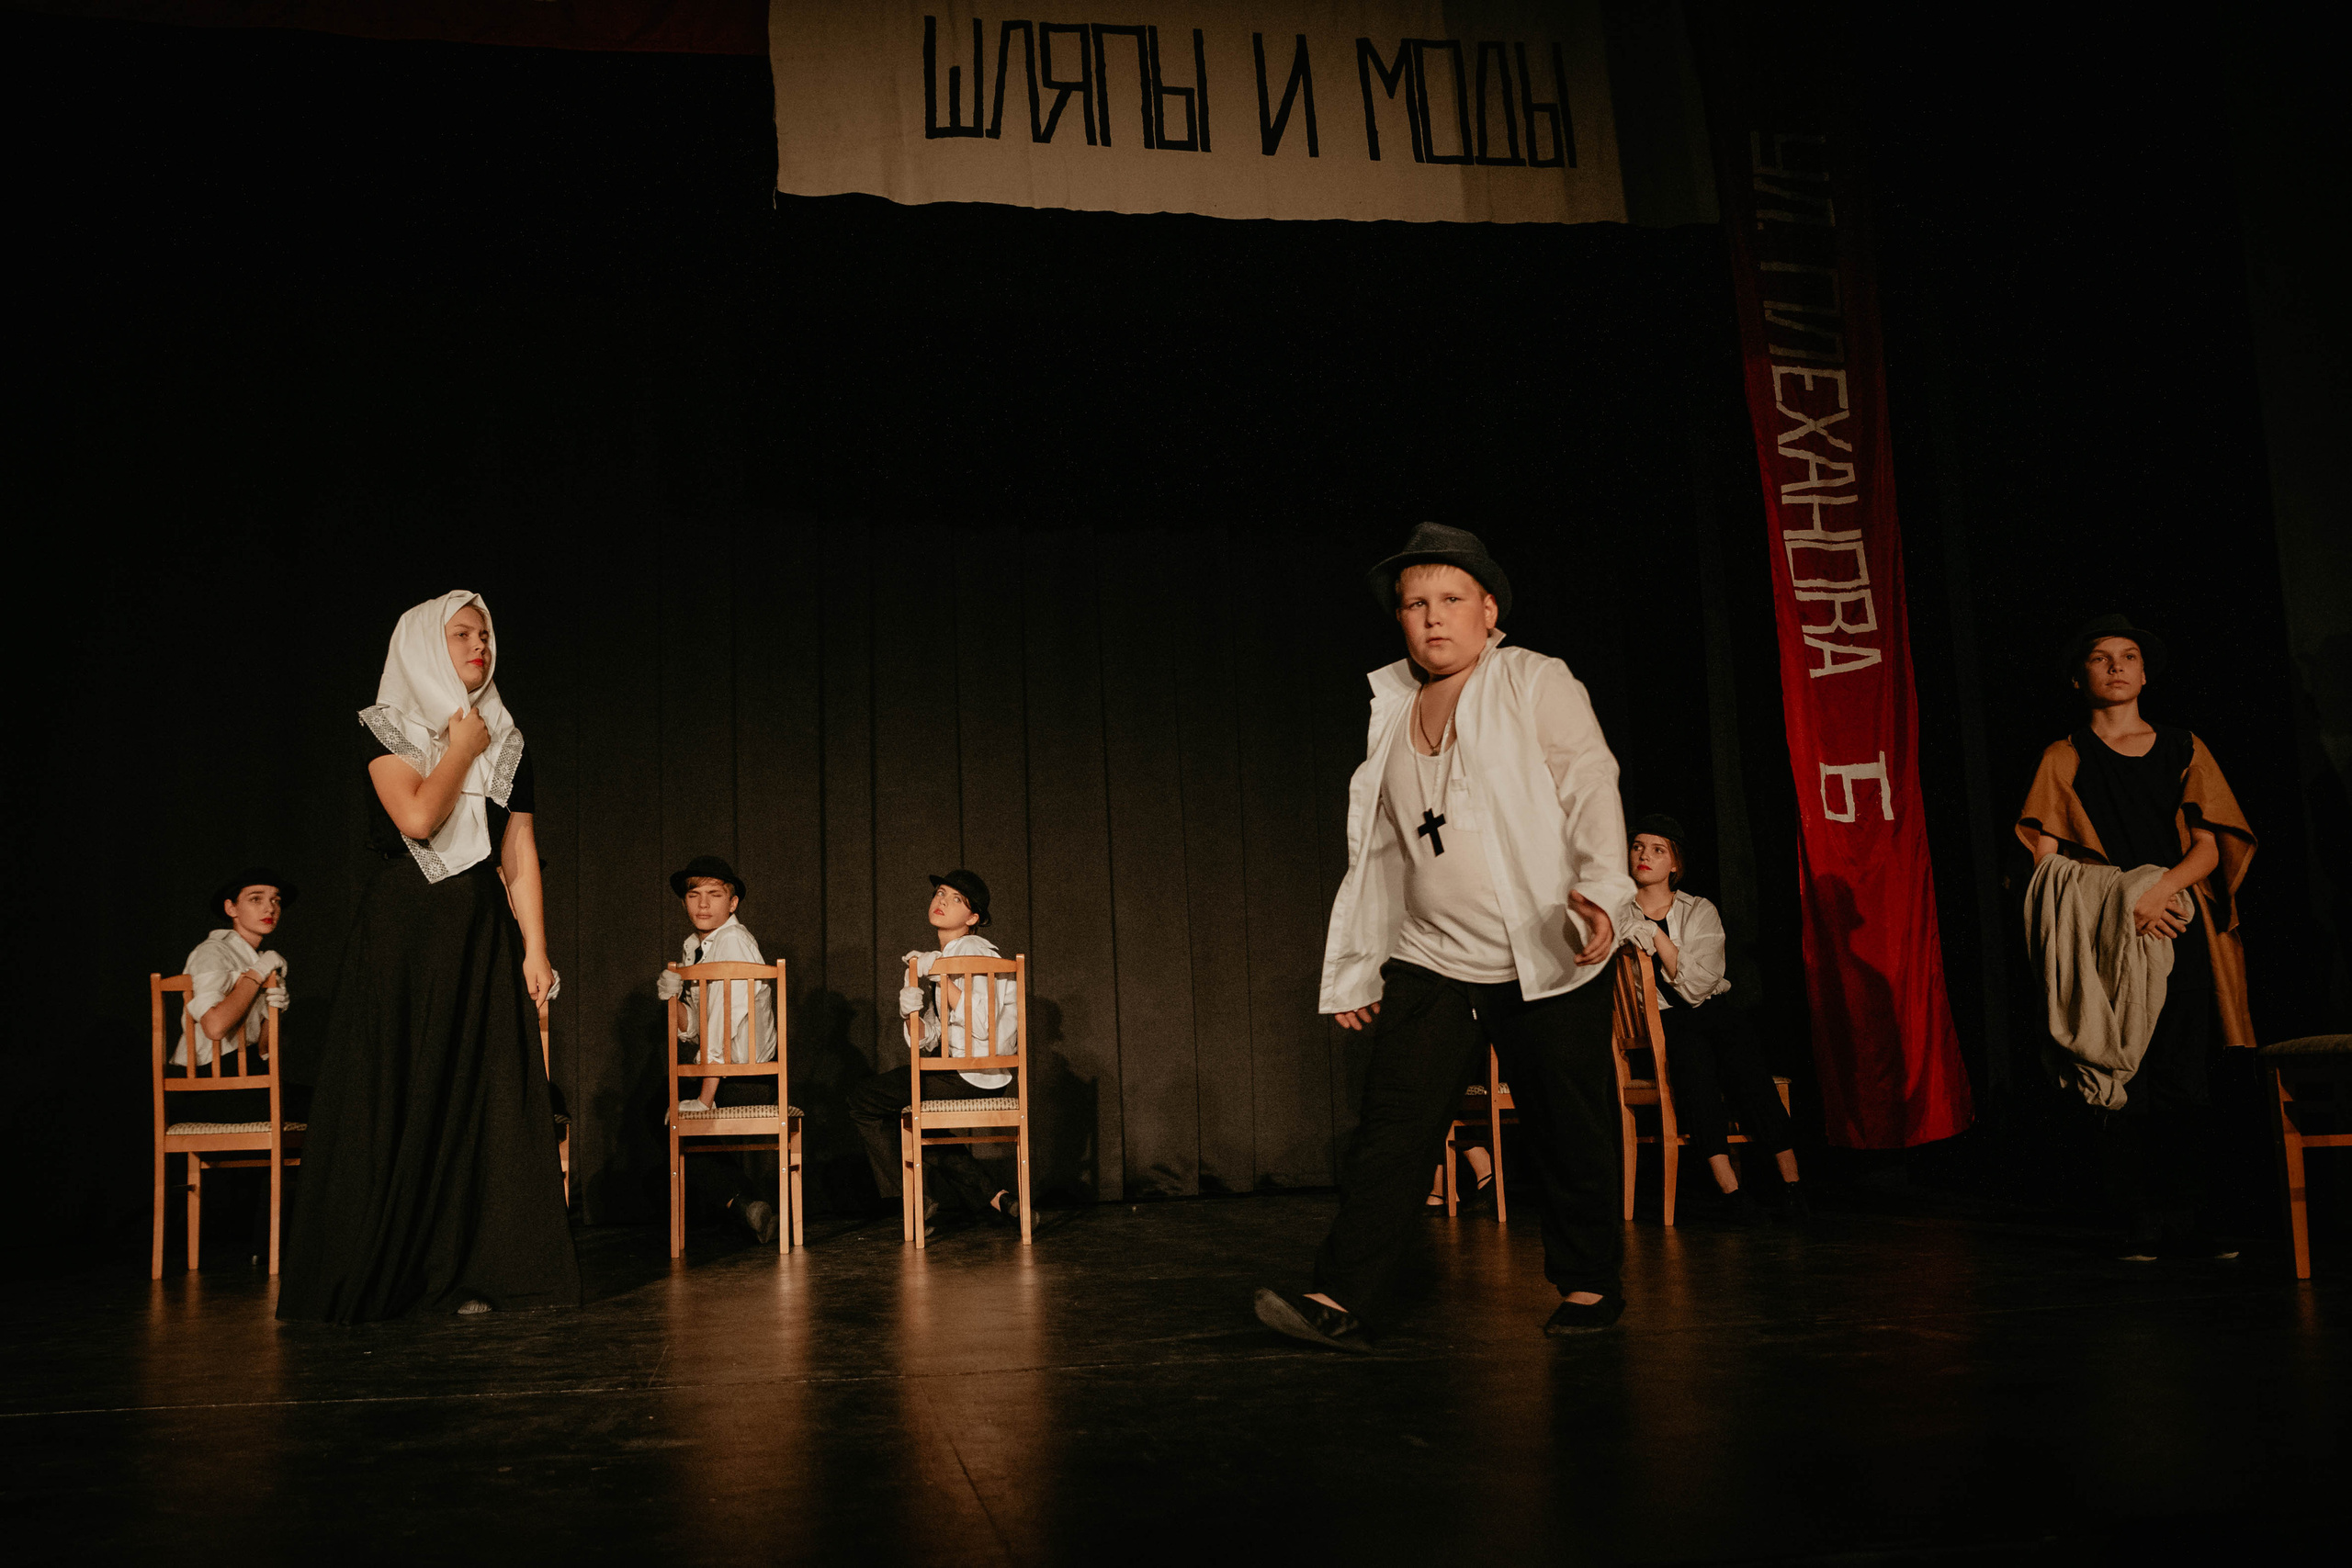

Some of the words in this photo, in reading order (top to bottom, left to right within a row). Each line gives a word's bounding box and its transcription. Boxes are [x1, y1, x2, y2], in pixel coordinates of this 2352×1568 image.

[923, 16, 1211, 152] ШЛЯПЫ
[1253, 33, 1318, 157] И
[1356, 37, 1577, 168] МОДЫ
